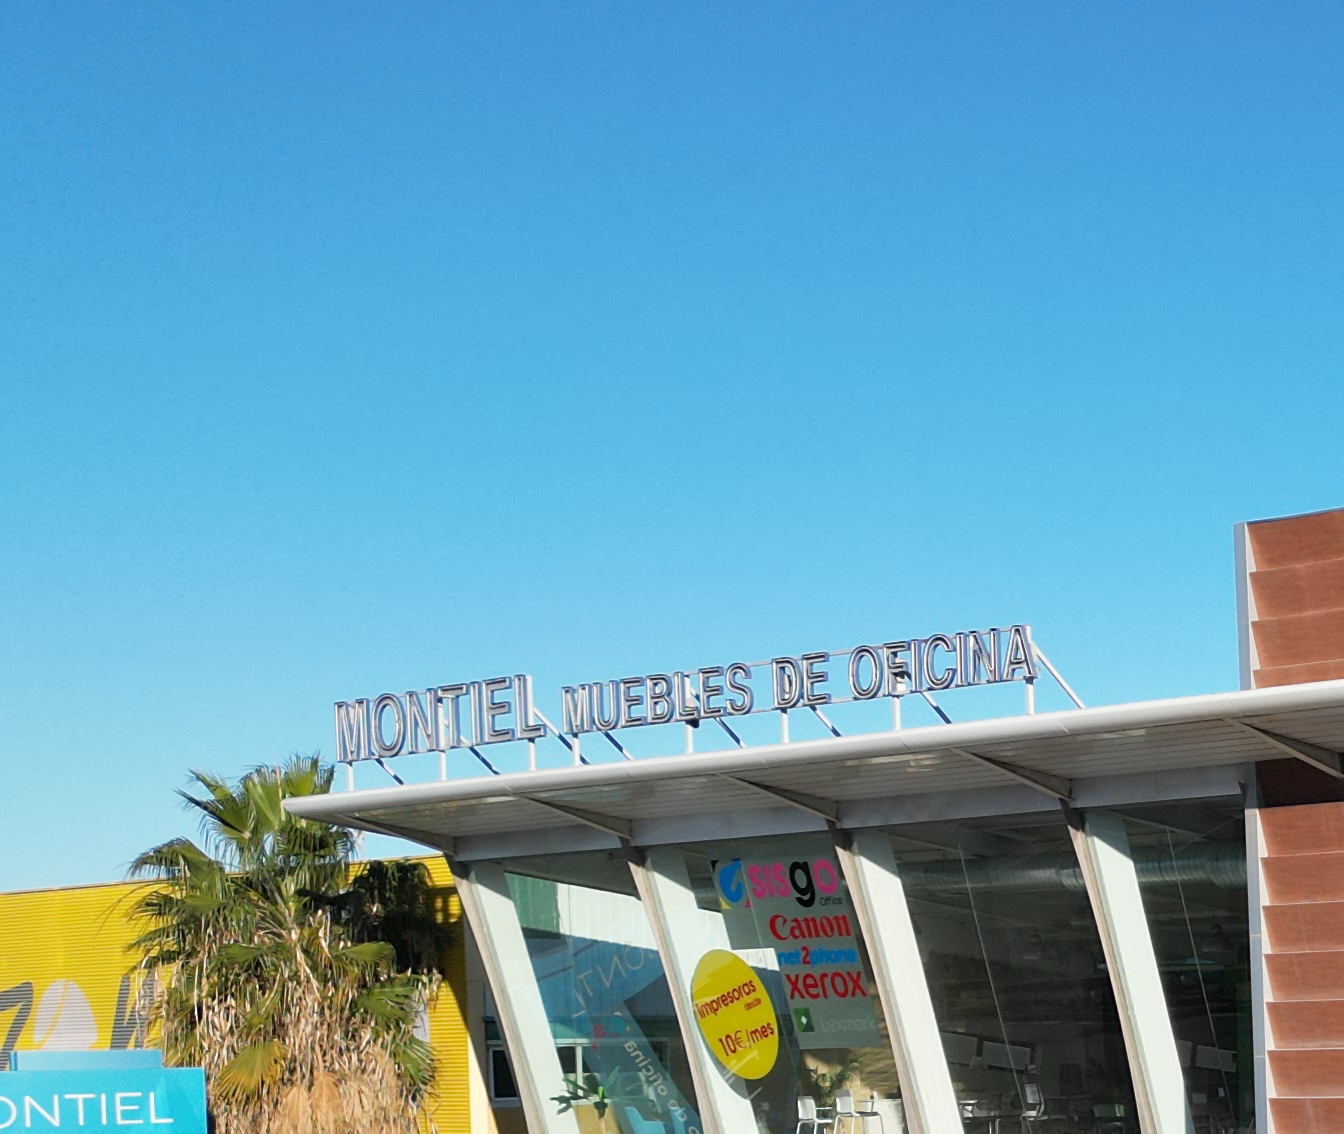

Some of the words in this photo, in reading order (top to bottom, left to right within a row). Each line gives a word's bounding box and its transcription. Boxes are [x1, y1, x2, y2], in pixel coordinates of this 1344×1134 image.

[334, 675, 546, 763] MONTIEL
[561, 663, 753, 734] MUEBLES
[771, 652, 831, 710] DE
[848, 625, 1037, 700] OFICINA
[747, 858, 838, 908] sisgo
[769, 914, 852, 941] Canon
[778, 946, 857, 968] net2phone
[695, 980, 757, 1019] Impresoras
[785, 971, 868, 1000] xerox
[820, 1015, 876, 1033] Lexmark
